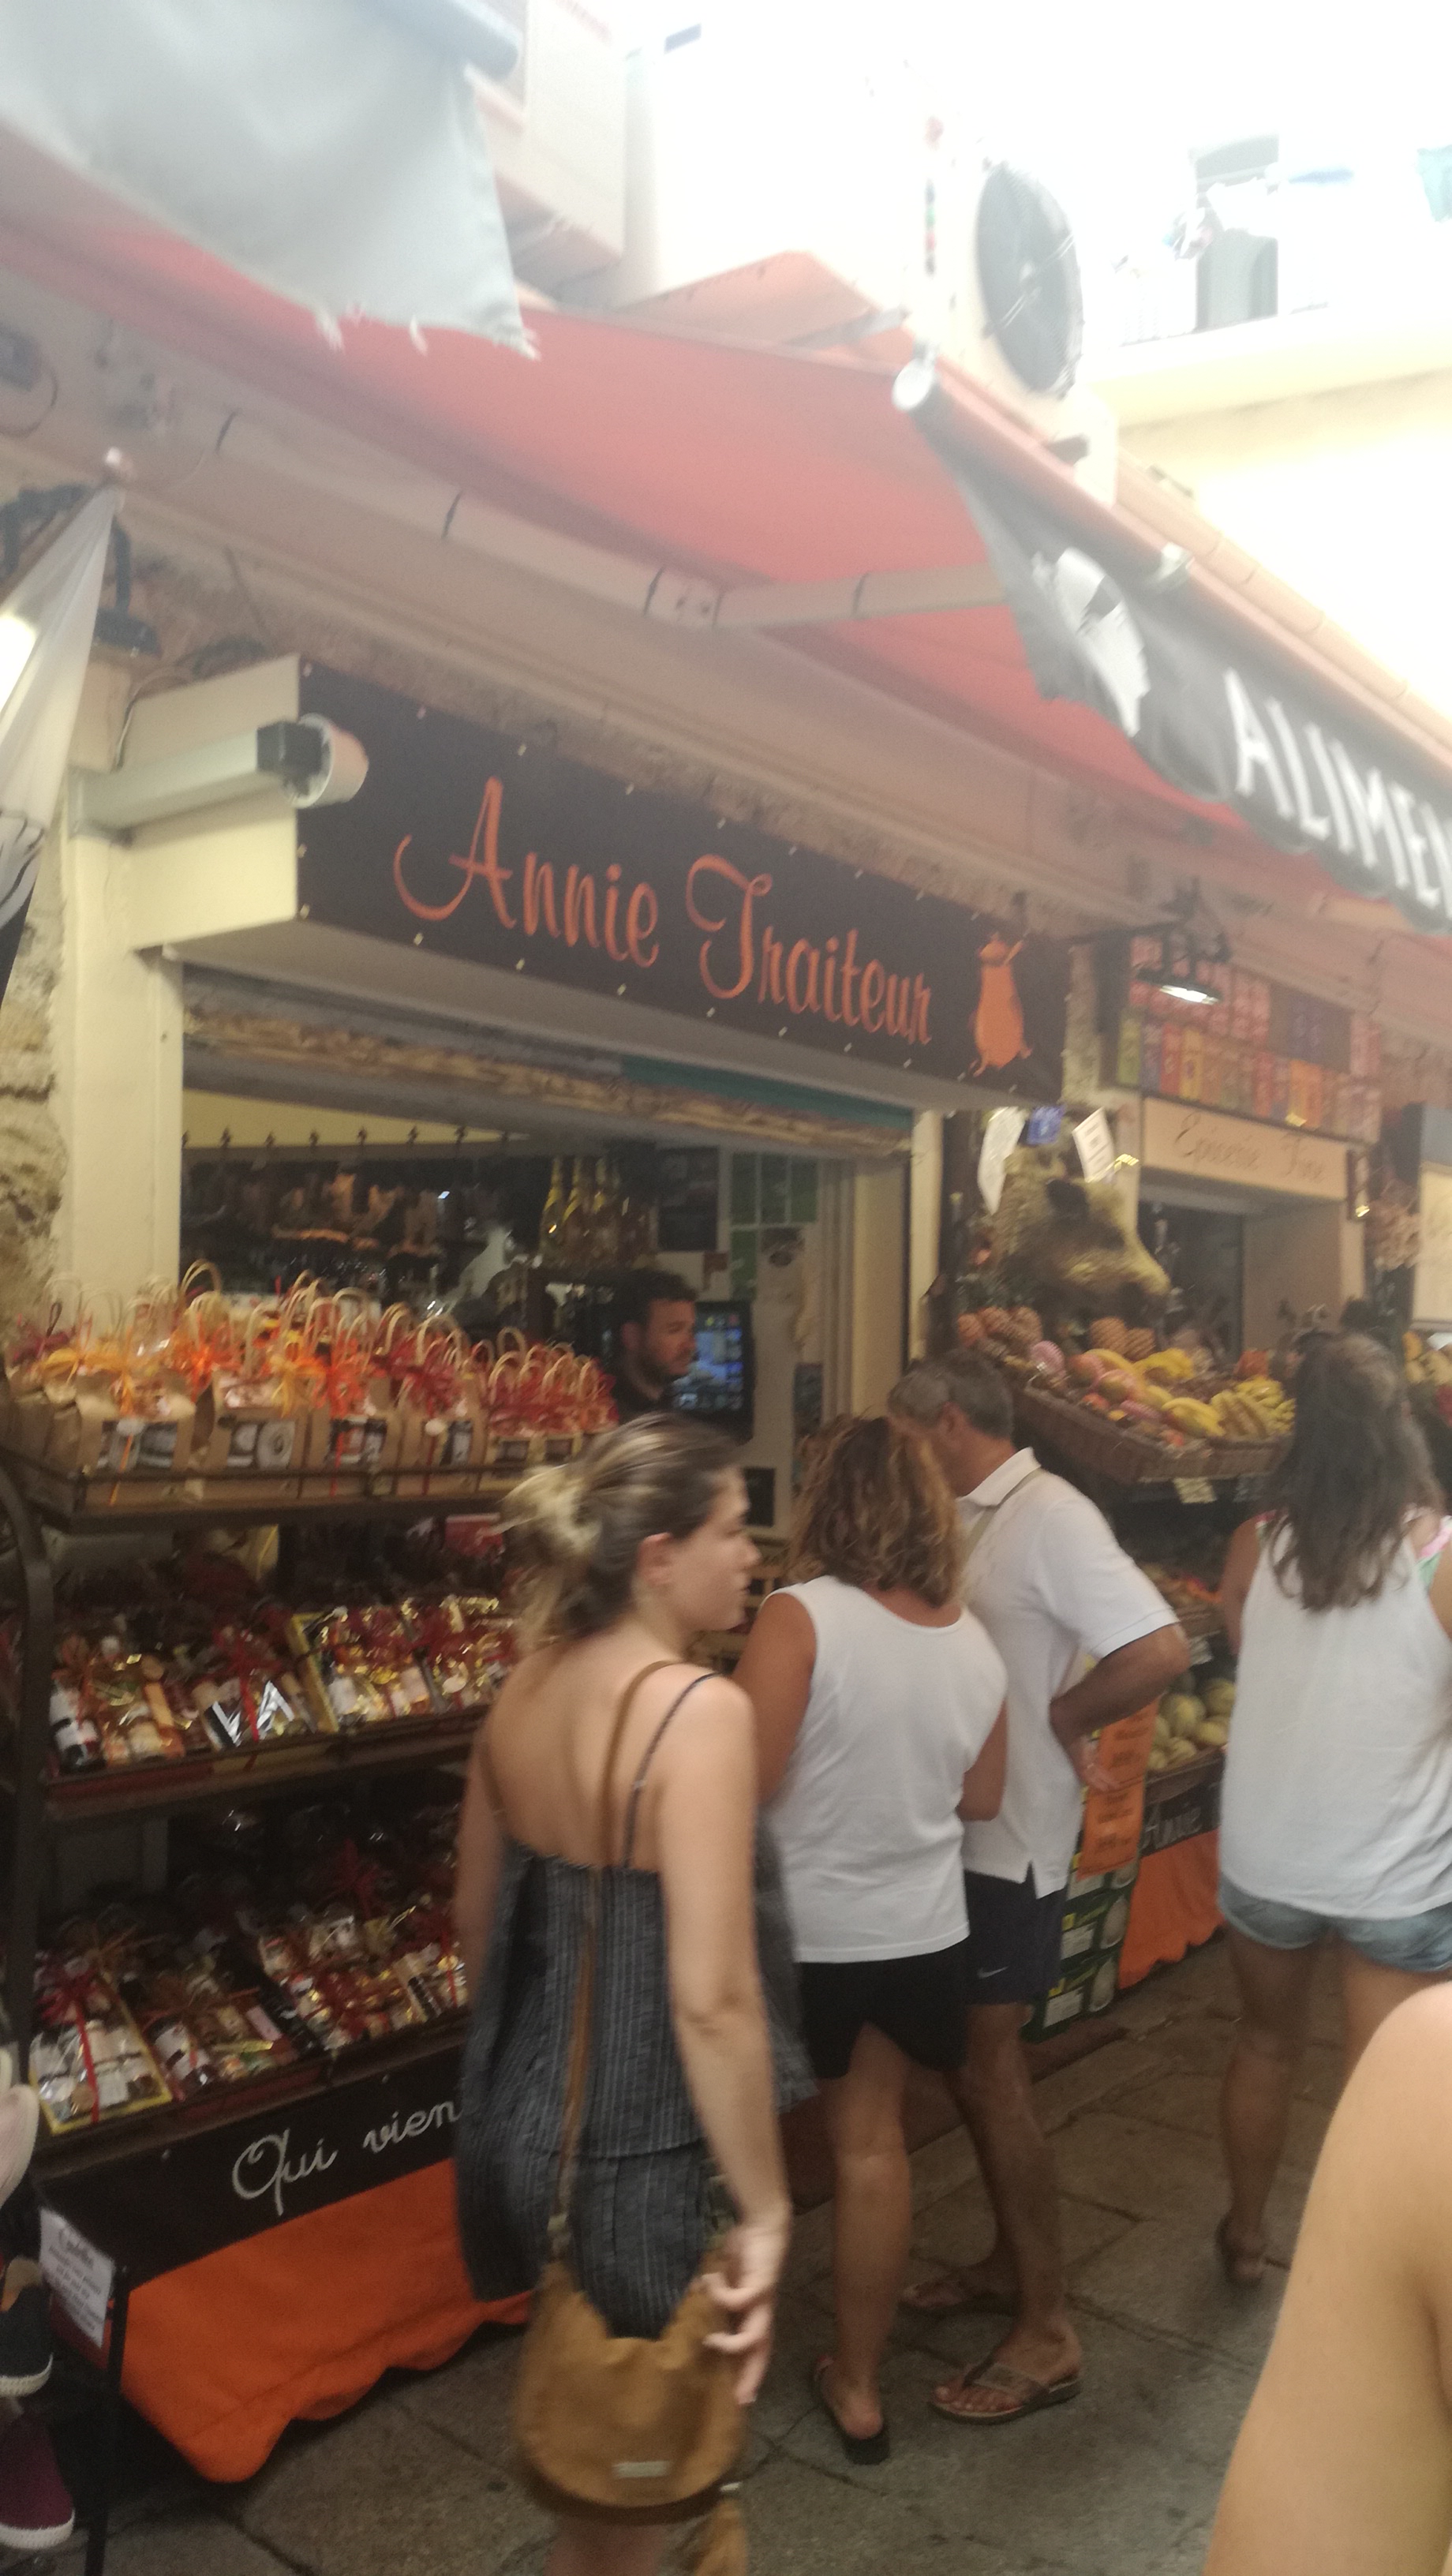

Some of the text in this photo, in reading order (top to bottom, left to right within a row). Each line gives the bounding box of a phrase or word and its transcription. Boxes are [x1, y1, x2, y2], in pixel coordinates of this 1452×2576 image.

[394, 776, 932, 1046] Annie Traiteur
[232, 2101, 463, 2216] Qui vien
